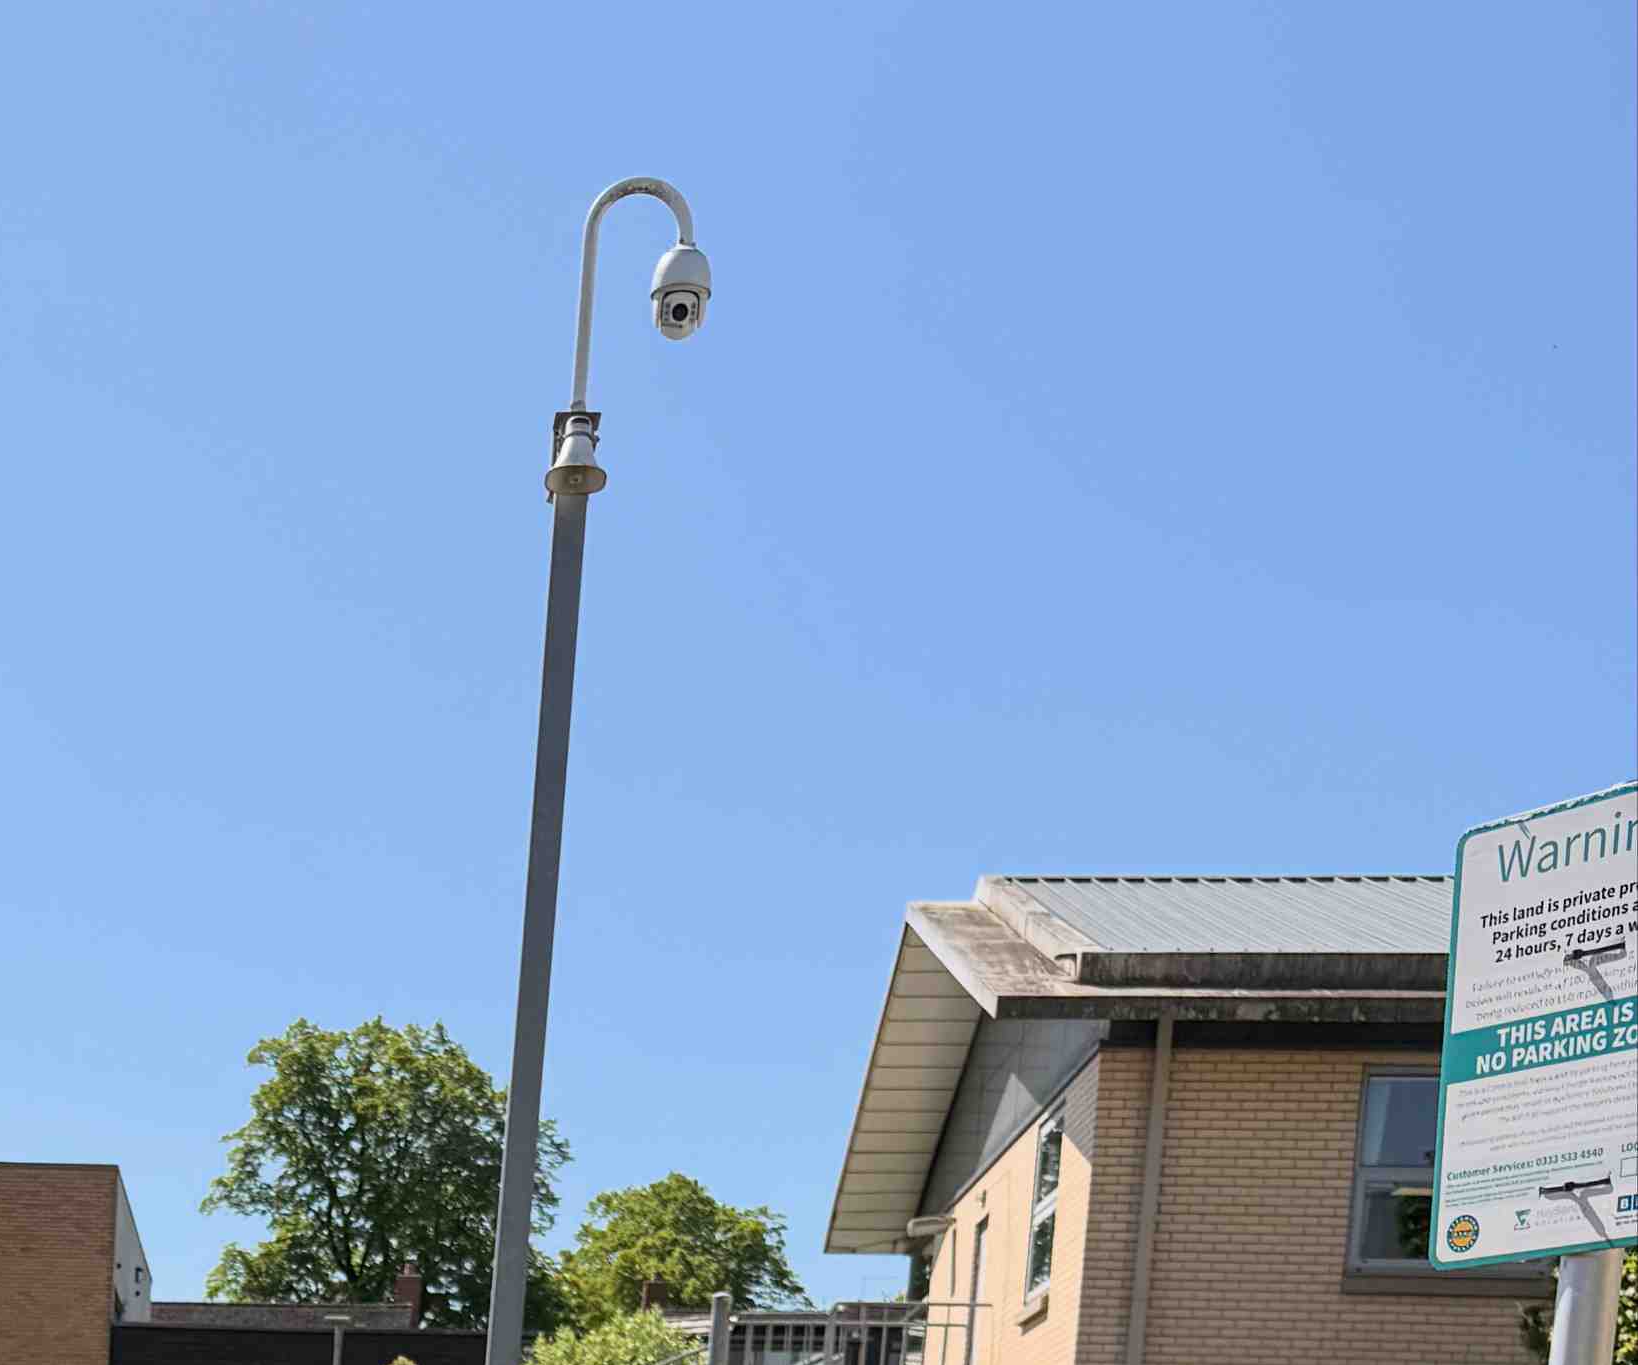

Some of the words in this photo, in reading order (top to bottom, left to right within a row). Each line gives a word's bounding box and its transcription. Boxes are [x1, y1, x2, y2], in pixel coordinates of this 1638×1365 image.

[1480, 910, 1510, 928] This
[1513, 900, 1544, 921] land
[1548, 898, 1560, 912] is
[1563, 886, 1616, 912] private
[1492, 923, 1547, 944] Parking
[1551, 904, 1628, 930] conditions
[1495, 947, 1512, 963] 24
[1515, 939, 1561, 958] hours,
[1565, 933, 1574, 947] 7
[1577, 926, 1612, 945] days
[1615, 924, 1624, 935] a
[1498, 1020, 1547, 1047] THIS
[1550, 1007, 1608, 1038] AREA
[1612, 1002, 1634, 1024] IS
[1476, 1051, 1507, 1075] NO
[1512, 1030, 1608, 1067] PARKING
[1447, 1166, 1491, 1181] Customer
